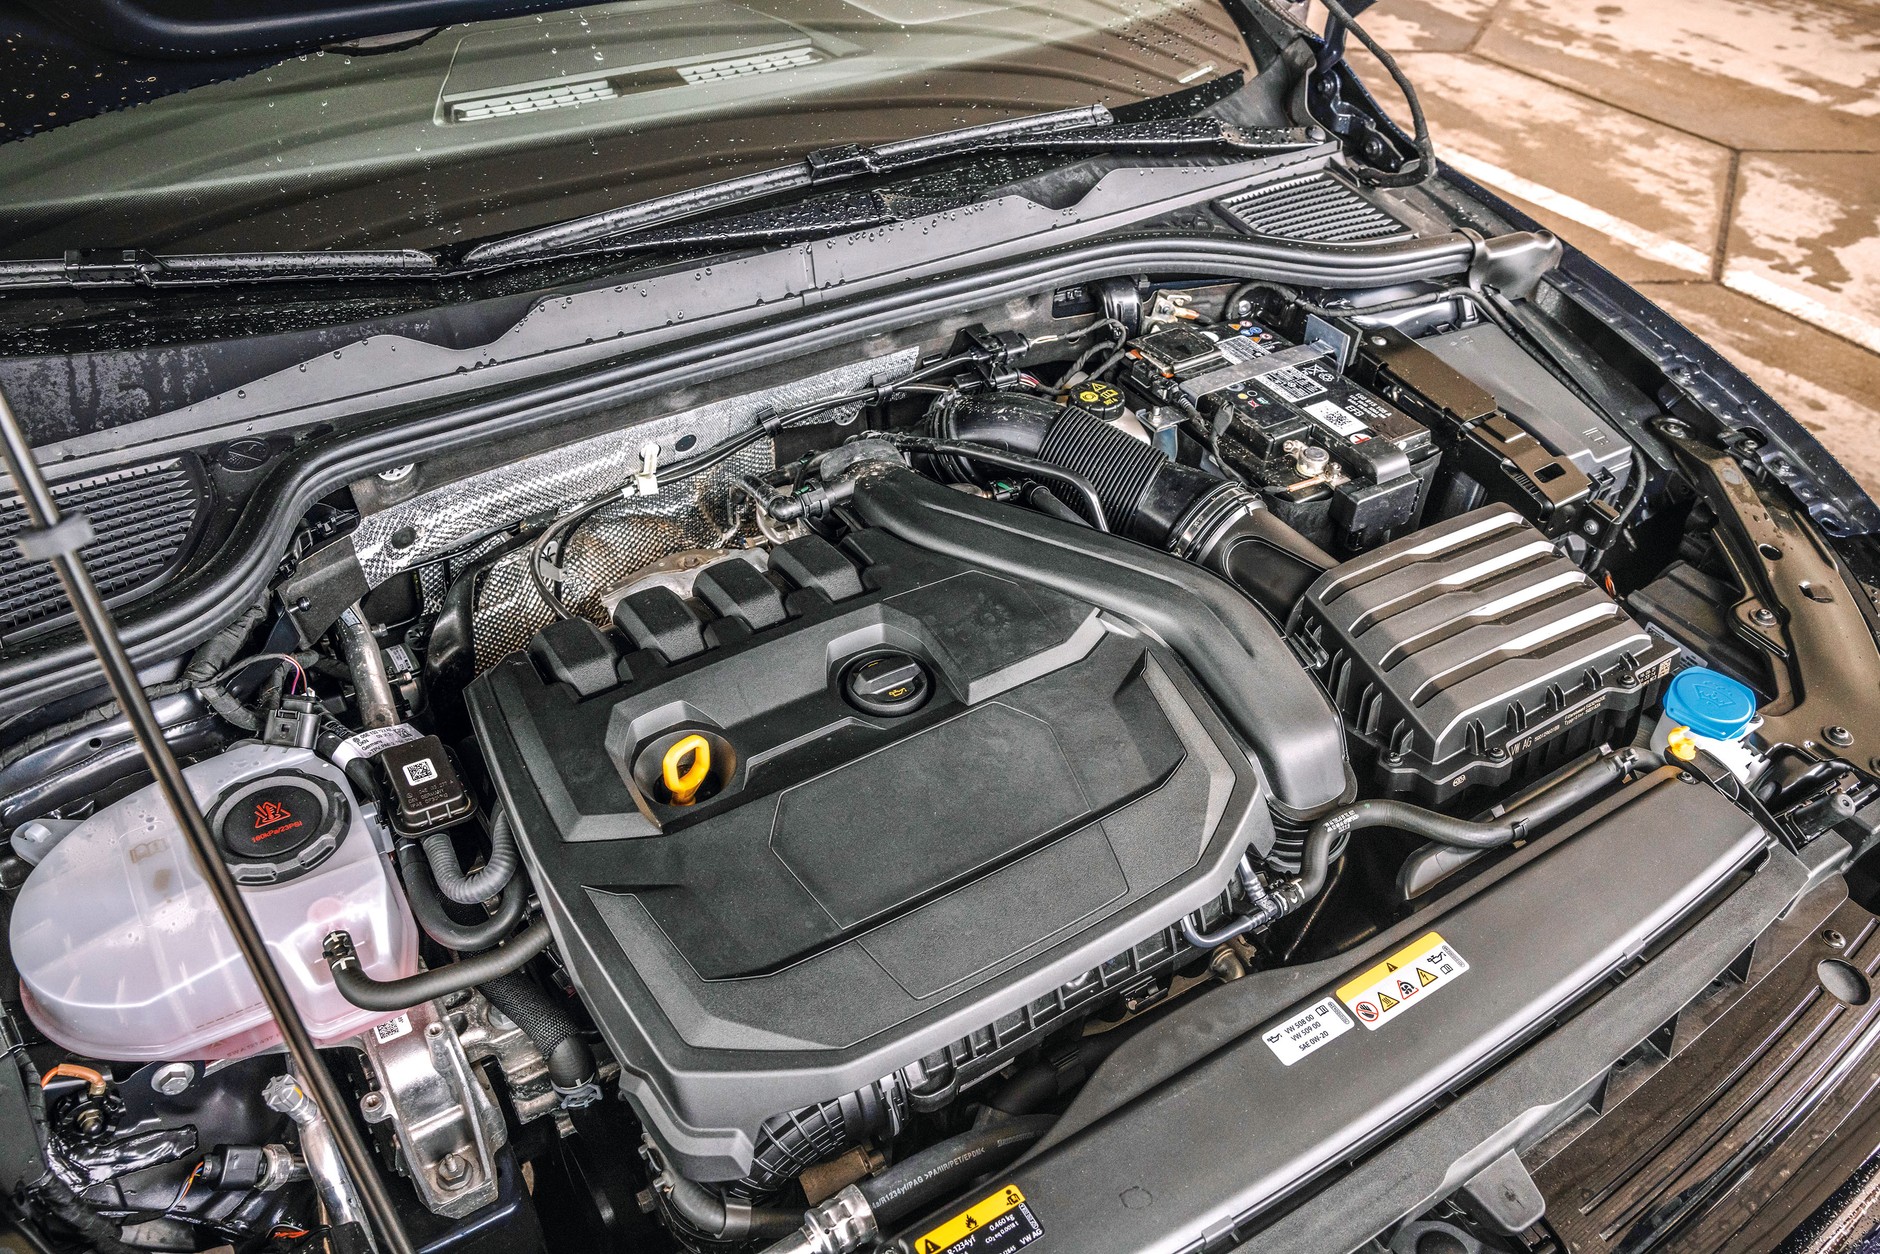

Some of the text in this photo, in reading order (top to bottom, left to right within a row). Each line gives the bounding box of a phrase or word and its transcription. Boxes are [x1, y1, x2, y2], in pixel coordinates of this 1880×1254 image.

[1345, 405, 1364, 416] EFB
[1510, 736, 1533, 756] VW AG
[1284, 1014, 1315, 1034] VW 508 00
[1290, 1021, 1322, 1042] VW 509 00
[1298, 1030, 1329, 1052] SAE 0W-20
[989, 1217, 1007, 1232] 0.460
[1005, 1213, 1016, 1224] kg
[946, 1234, 977, 1254] R-1234yf
[1019, 1228, 1043, 1245] VW AG
